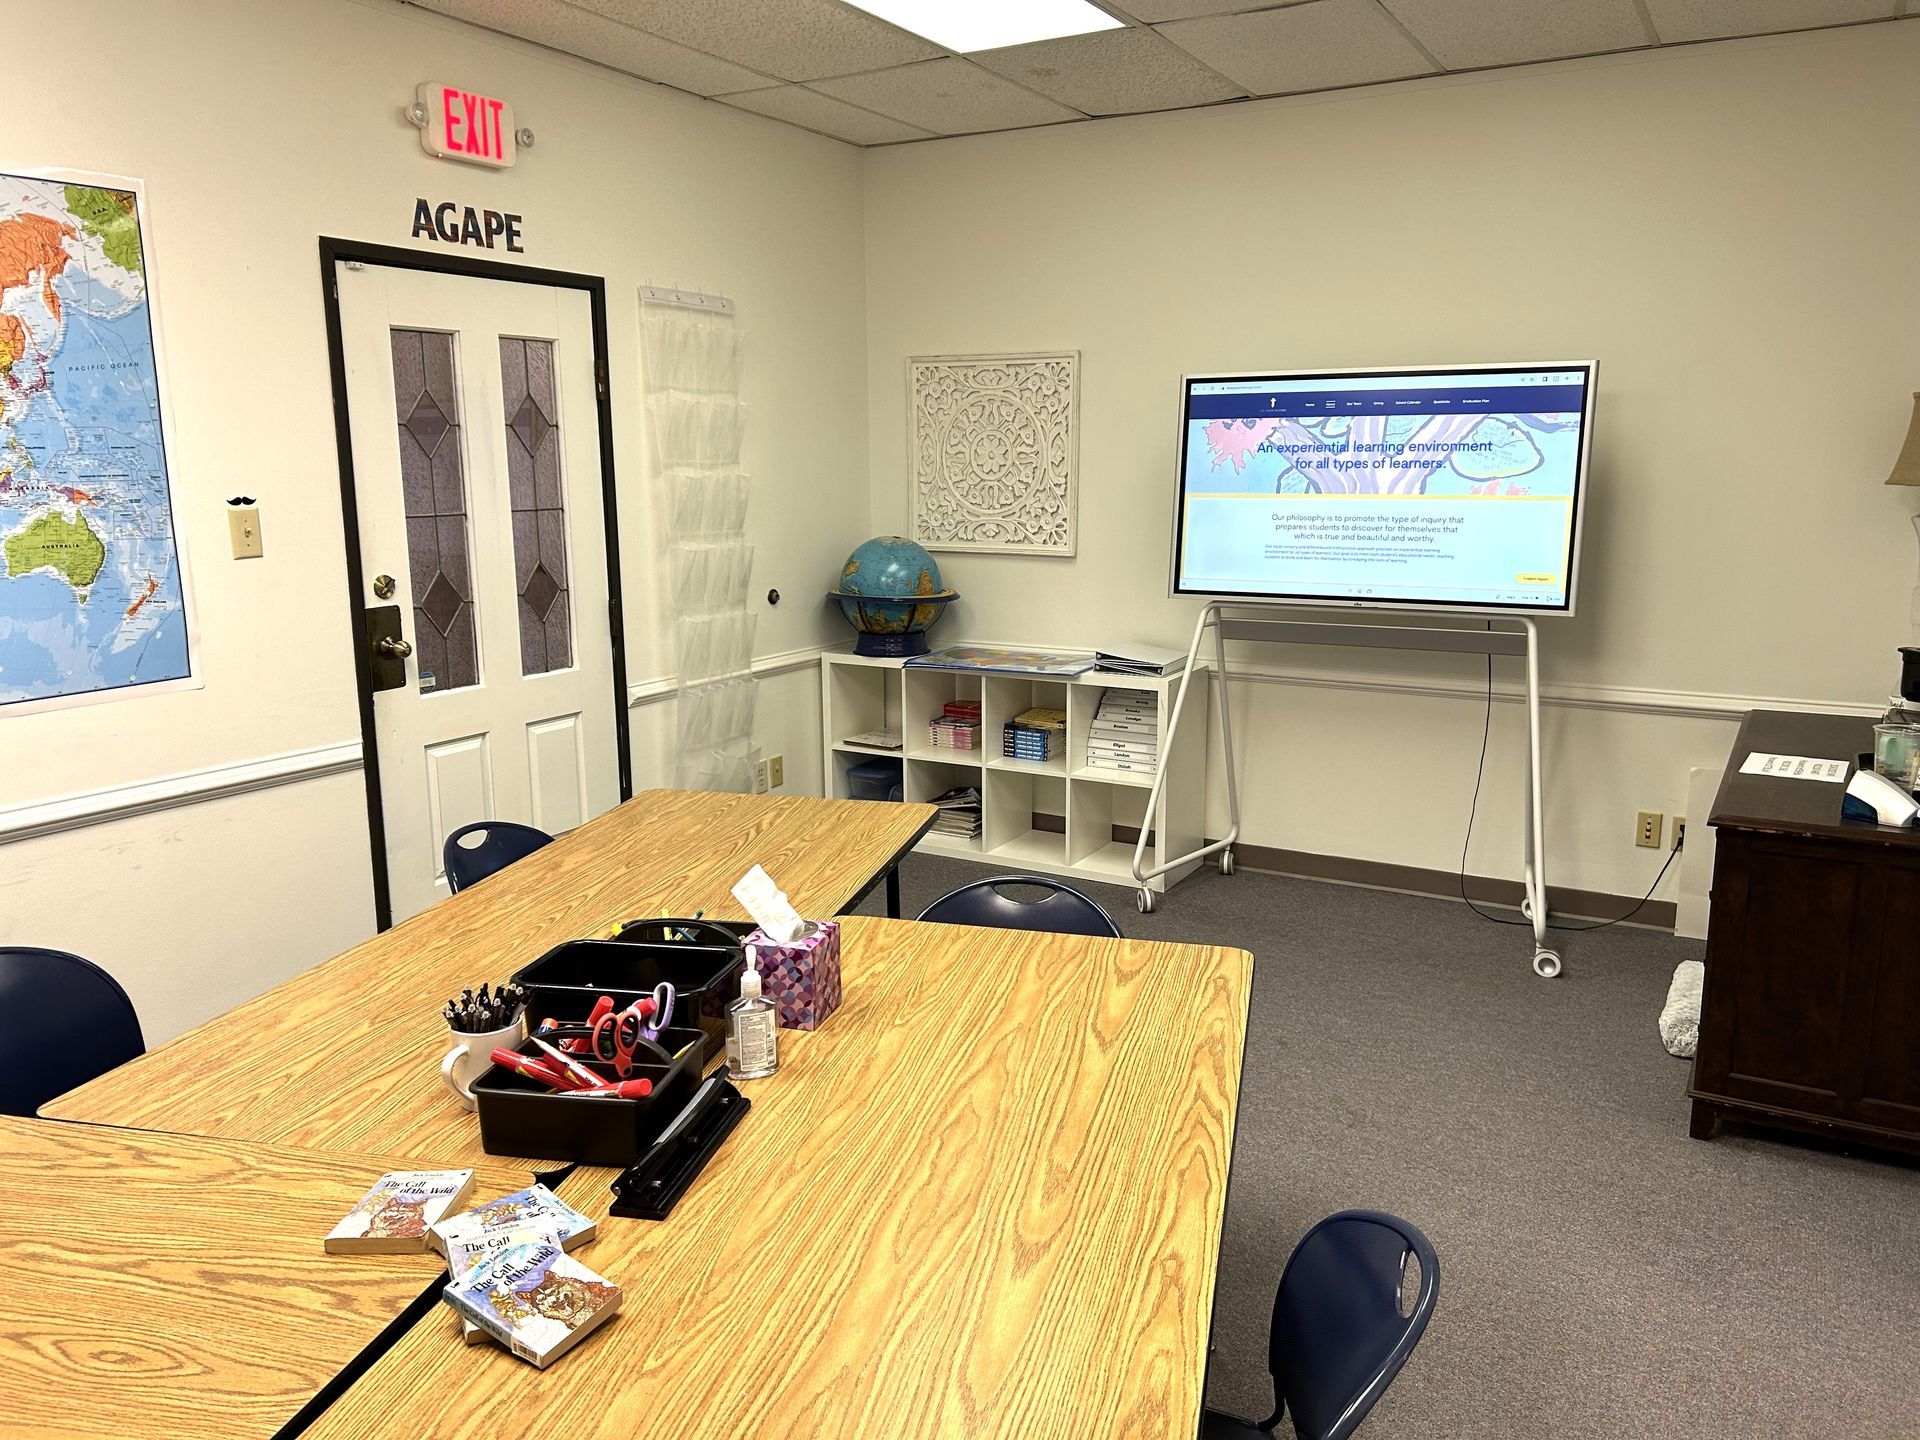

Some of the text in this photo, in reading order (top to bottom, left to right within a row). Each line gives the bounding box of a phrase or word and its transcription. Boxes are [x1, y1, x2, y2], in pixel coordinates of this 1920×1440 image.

[443, 88, 504, 160] EXIT
[412, 197, 524, 254] AGAPE
[68, 364, 106, 372] PACIFIC
[1257, 440, 1493, 455] An experiential learning environment
[1296, 458, 1446, 471] for all types of learners.
[1271, 514, 1286, 522] Our
[1287, 514, 1324, 523] philosophy
[1421, 516, 1447, 525] inquiry
[1351, 524, 1384, 532] discover
[1398, 525, 1441, 533] themselves
[1357, 533, 1389, 542] beautiful
[524, 1195, 540, 1207] The
[463, 1236, 510, 1253] The Call
[478, 1248, 510, 1270] Jack London
[504, 1248, 554, 1287] of the Wild
[470, 1263, 515, 1293] The Call
